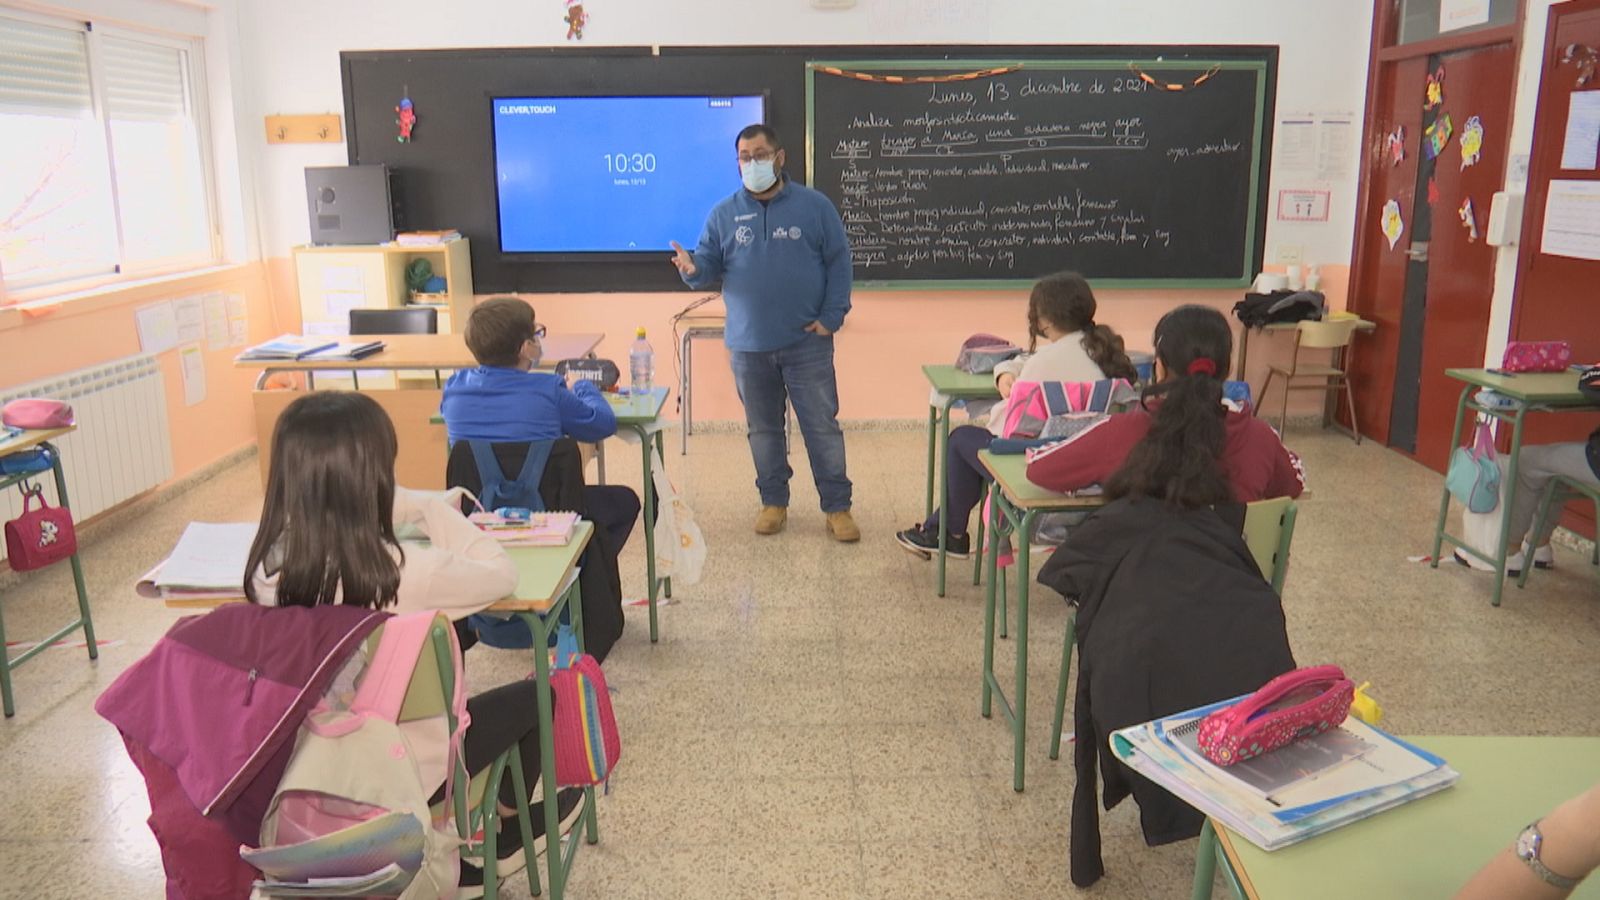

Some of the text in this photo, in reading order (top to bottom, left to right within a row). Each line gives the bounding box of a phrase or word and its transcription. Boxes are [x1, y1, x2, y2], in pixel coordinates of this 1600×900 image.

[928, 83, 977, 106] Lunes,
[987, 82, 1010, 103] 13
[1020, 77, 1082, 96] diciembre
[1089, 78, 1106, 95] de
[604, 153, 656, 173] 10:30
